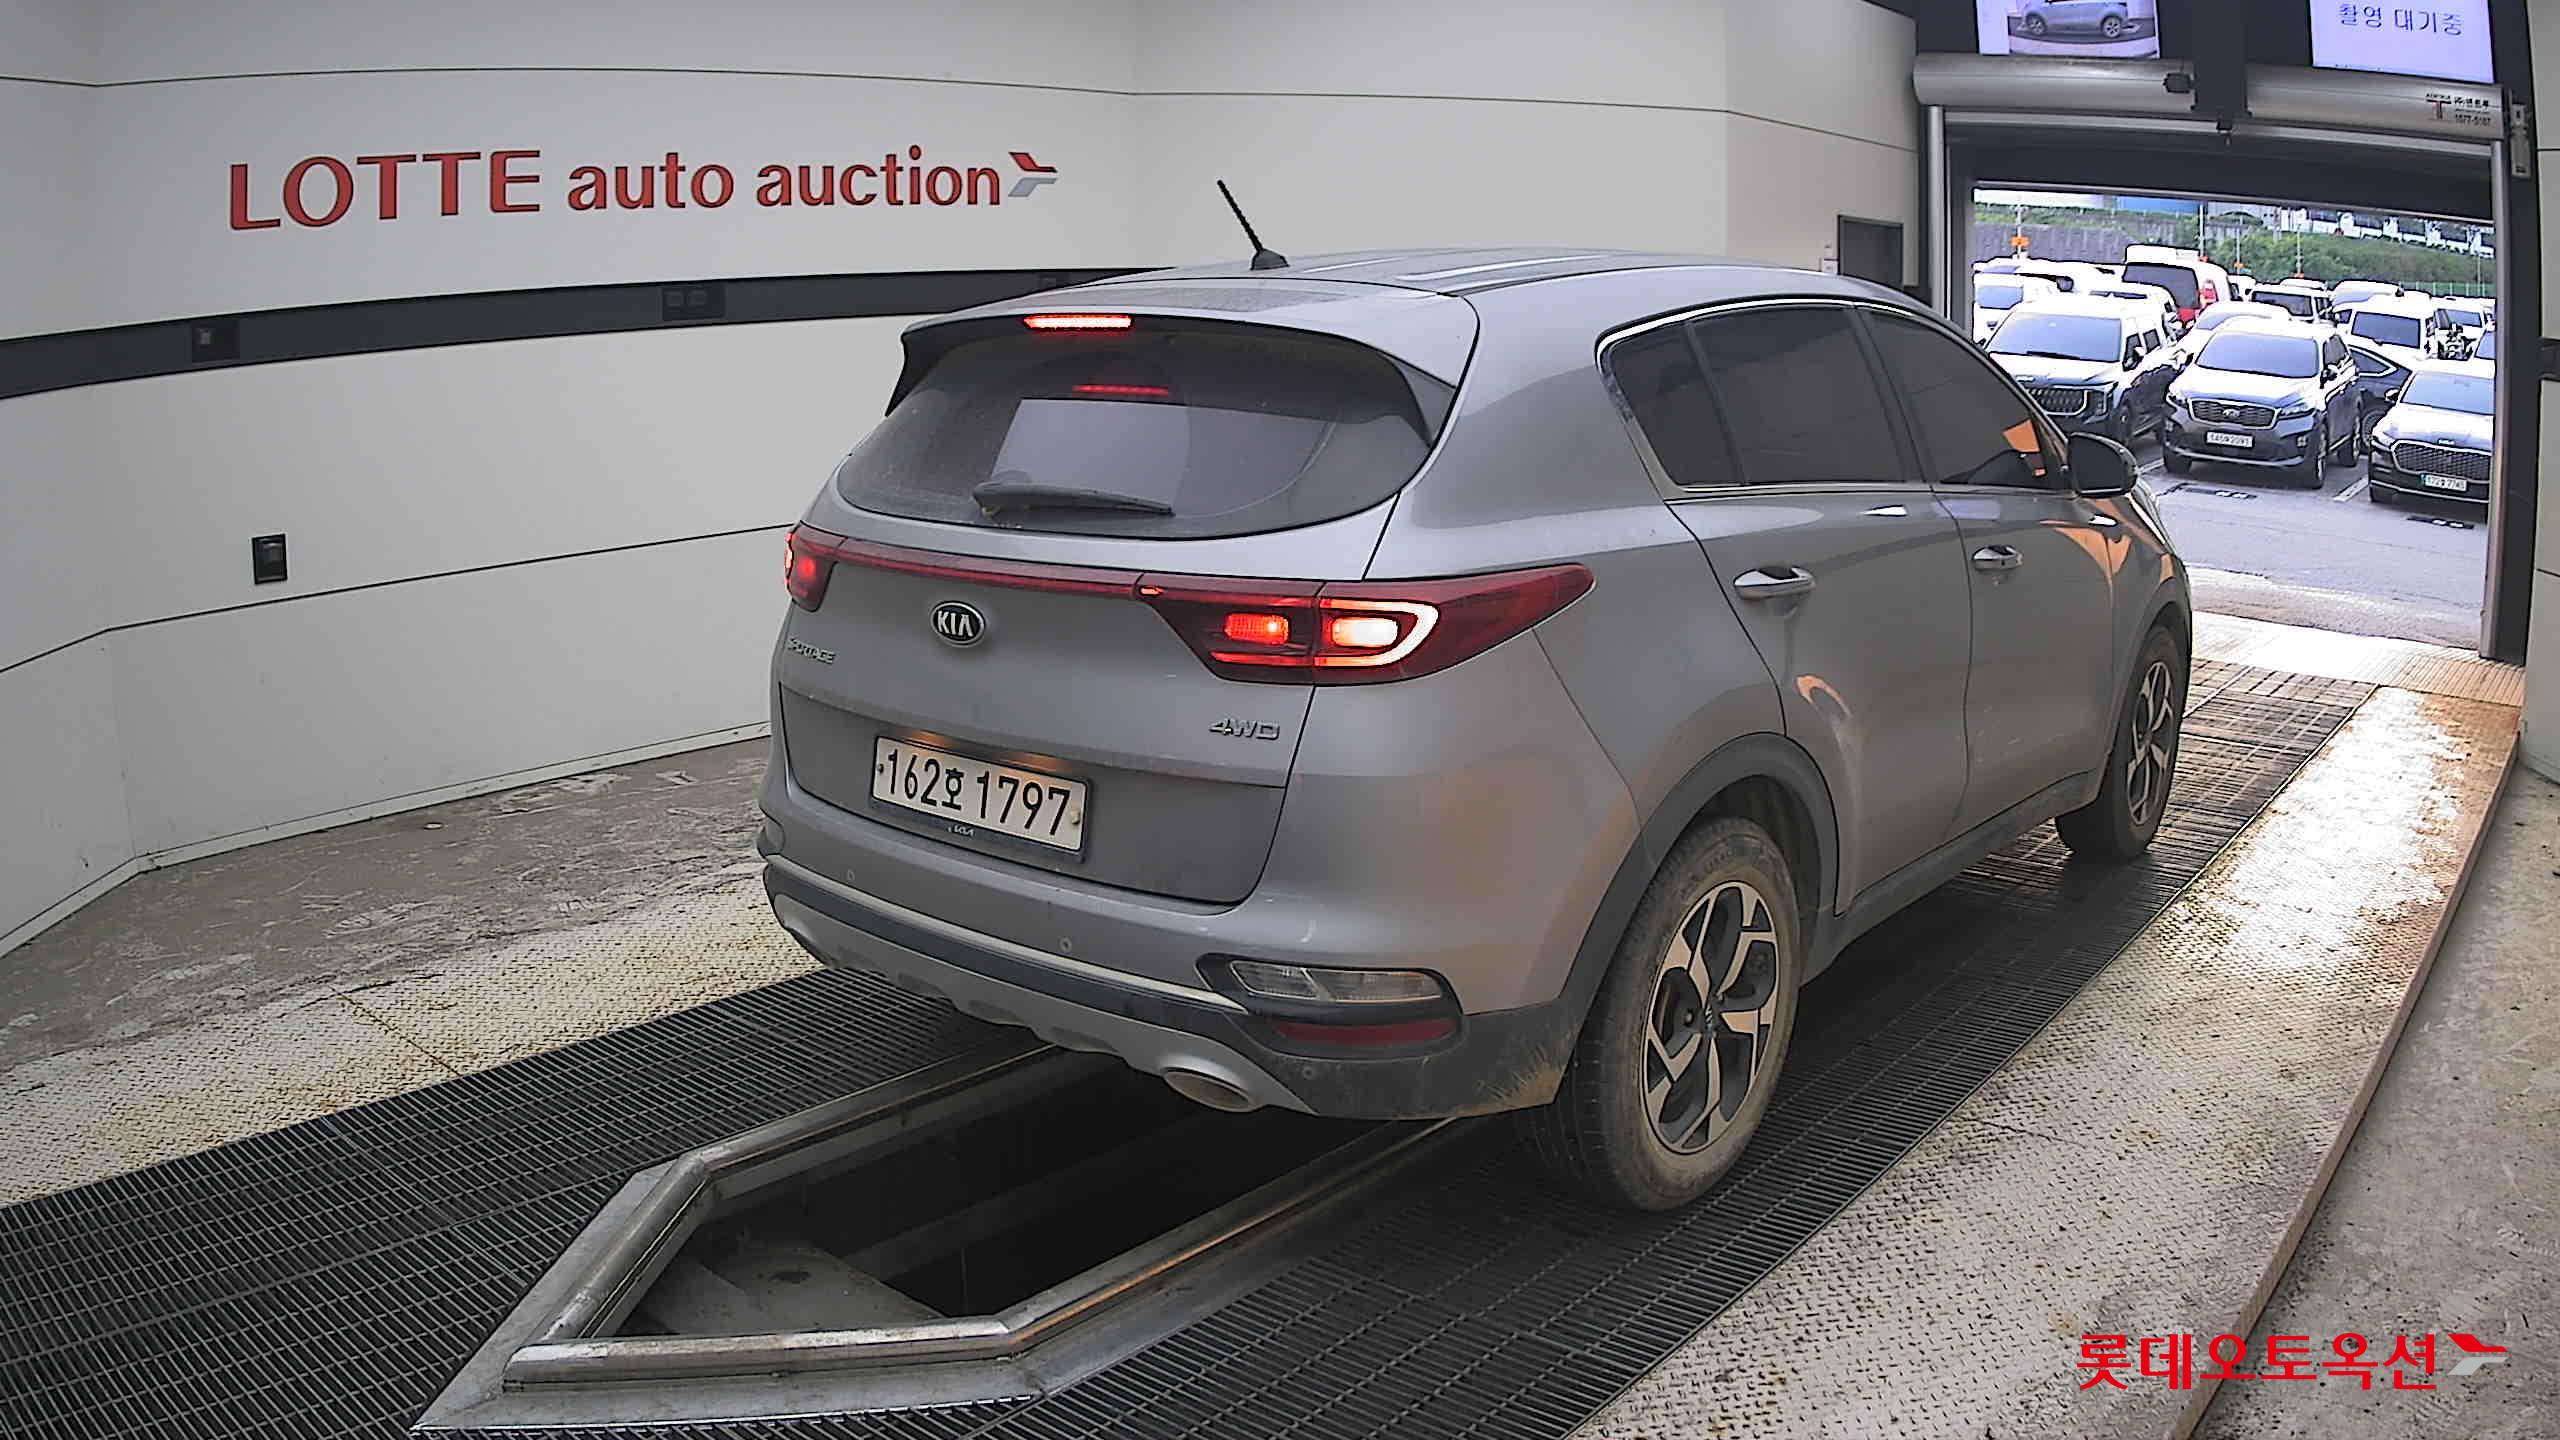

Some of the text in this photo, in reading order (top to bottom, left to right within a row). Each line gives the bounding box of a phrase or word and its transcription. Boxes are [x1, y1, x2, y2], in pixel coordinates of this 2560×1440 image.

[2394, 9, 2462, 36] 대기중
[229, 145, 1001, 230] LOTTE auto auction
[937, 610, 973, 637] KIA
[1208, 718, 1281, 741] 4WD
[888, 748, 1071, 836] 162호 1797
